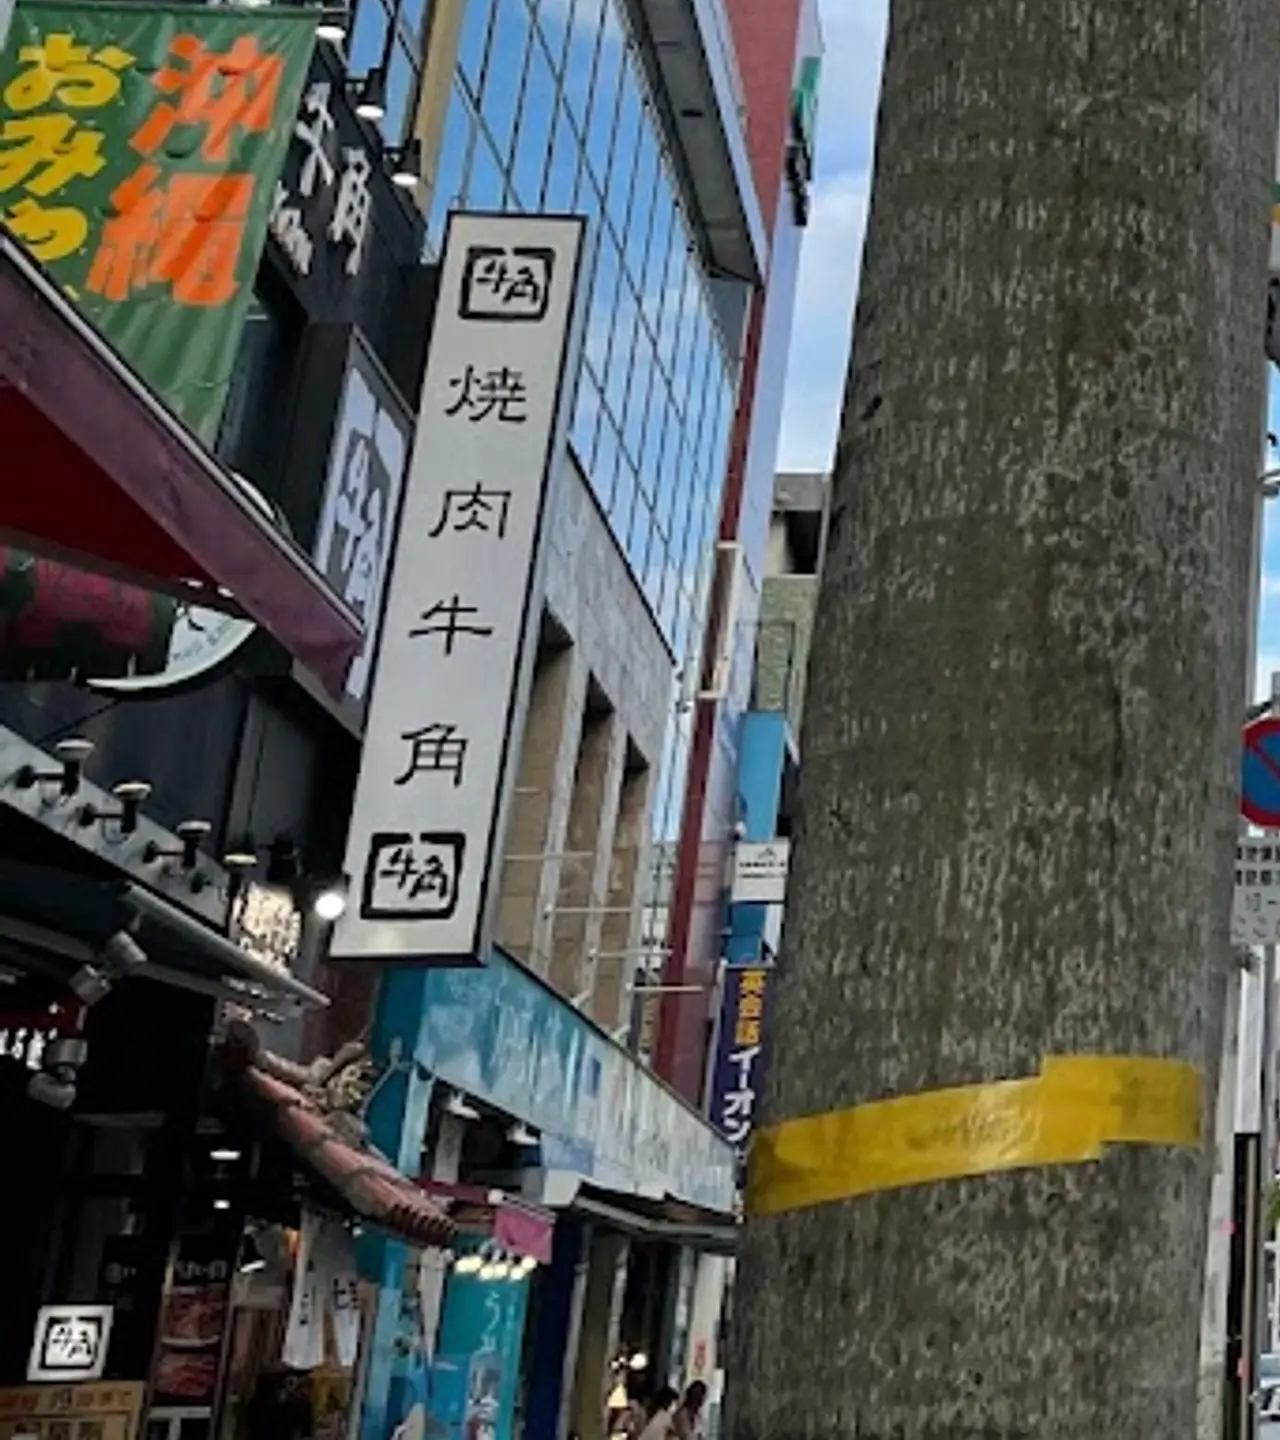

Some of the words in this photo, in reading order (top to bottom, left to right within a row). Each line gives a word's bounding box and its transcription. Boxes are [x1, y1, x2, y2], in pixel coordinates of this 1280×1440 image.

[86, 34, 285, 305] 沖縄
[474, 258, 542, 304] 牛角
[394, 365, 529, 788] 焼肉牛角
[377, 847, 451, 901] 牛角
[51, 1327, 93, 1358] 牛角
